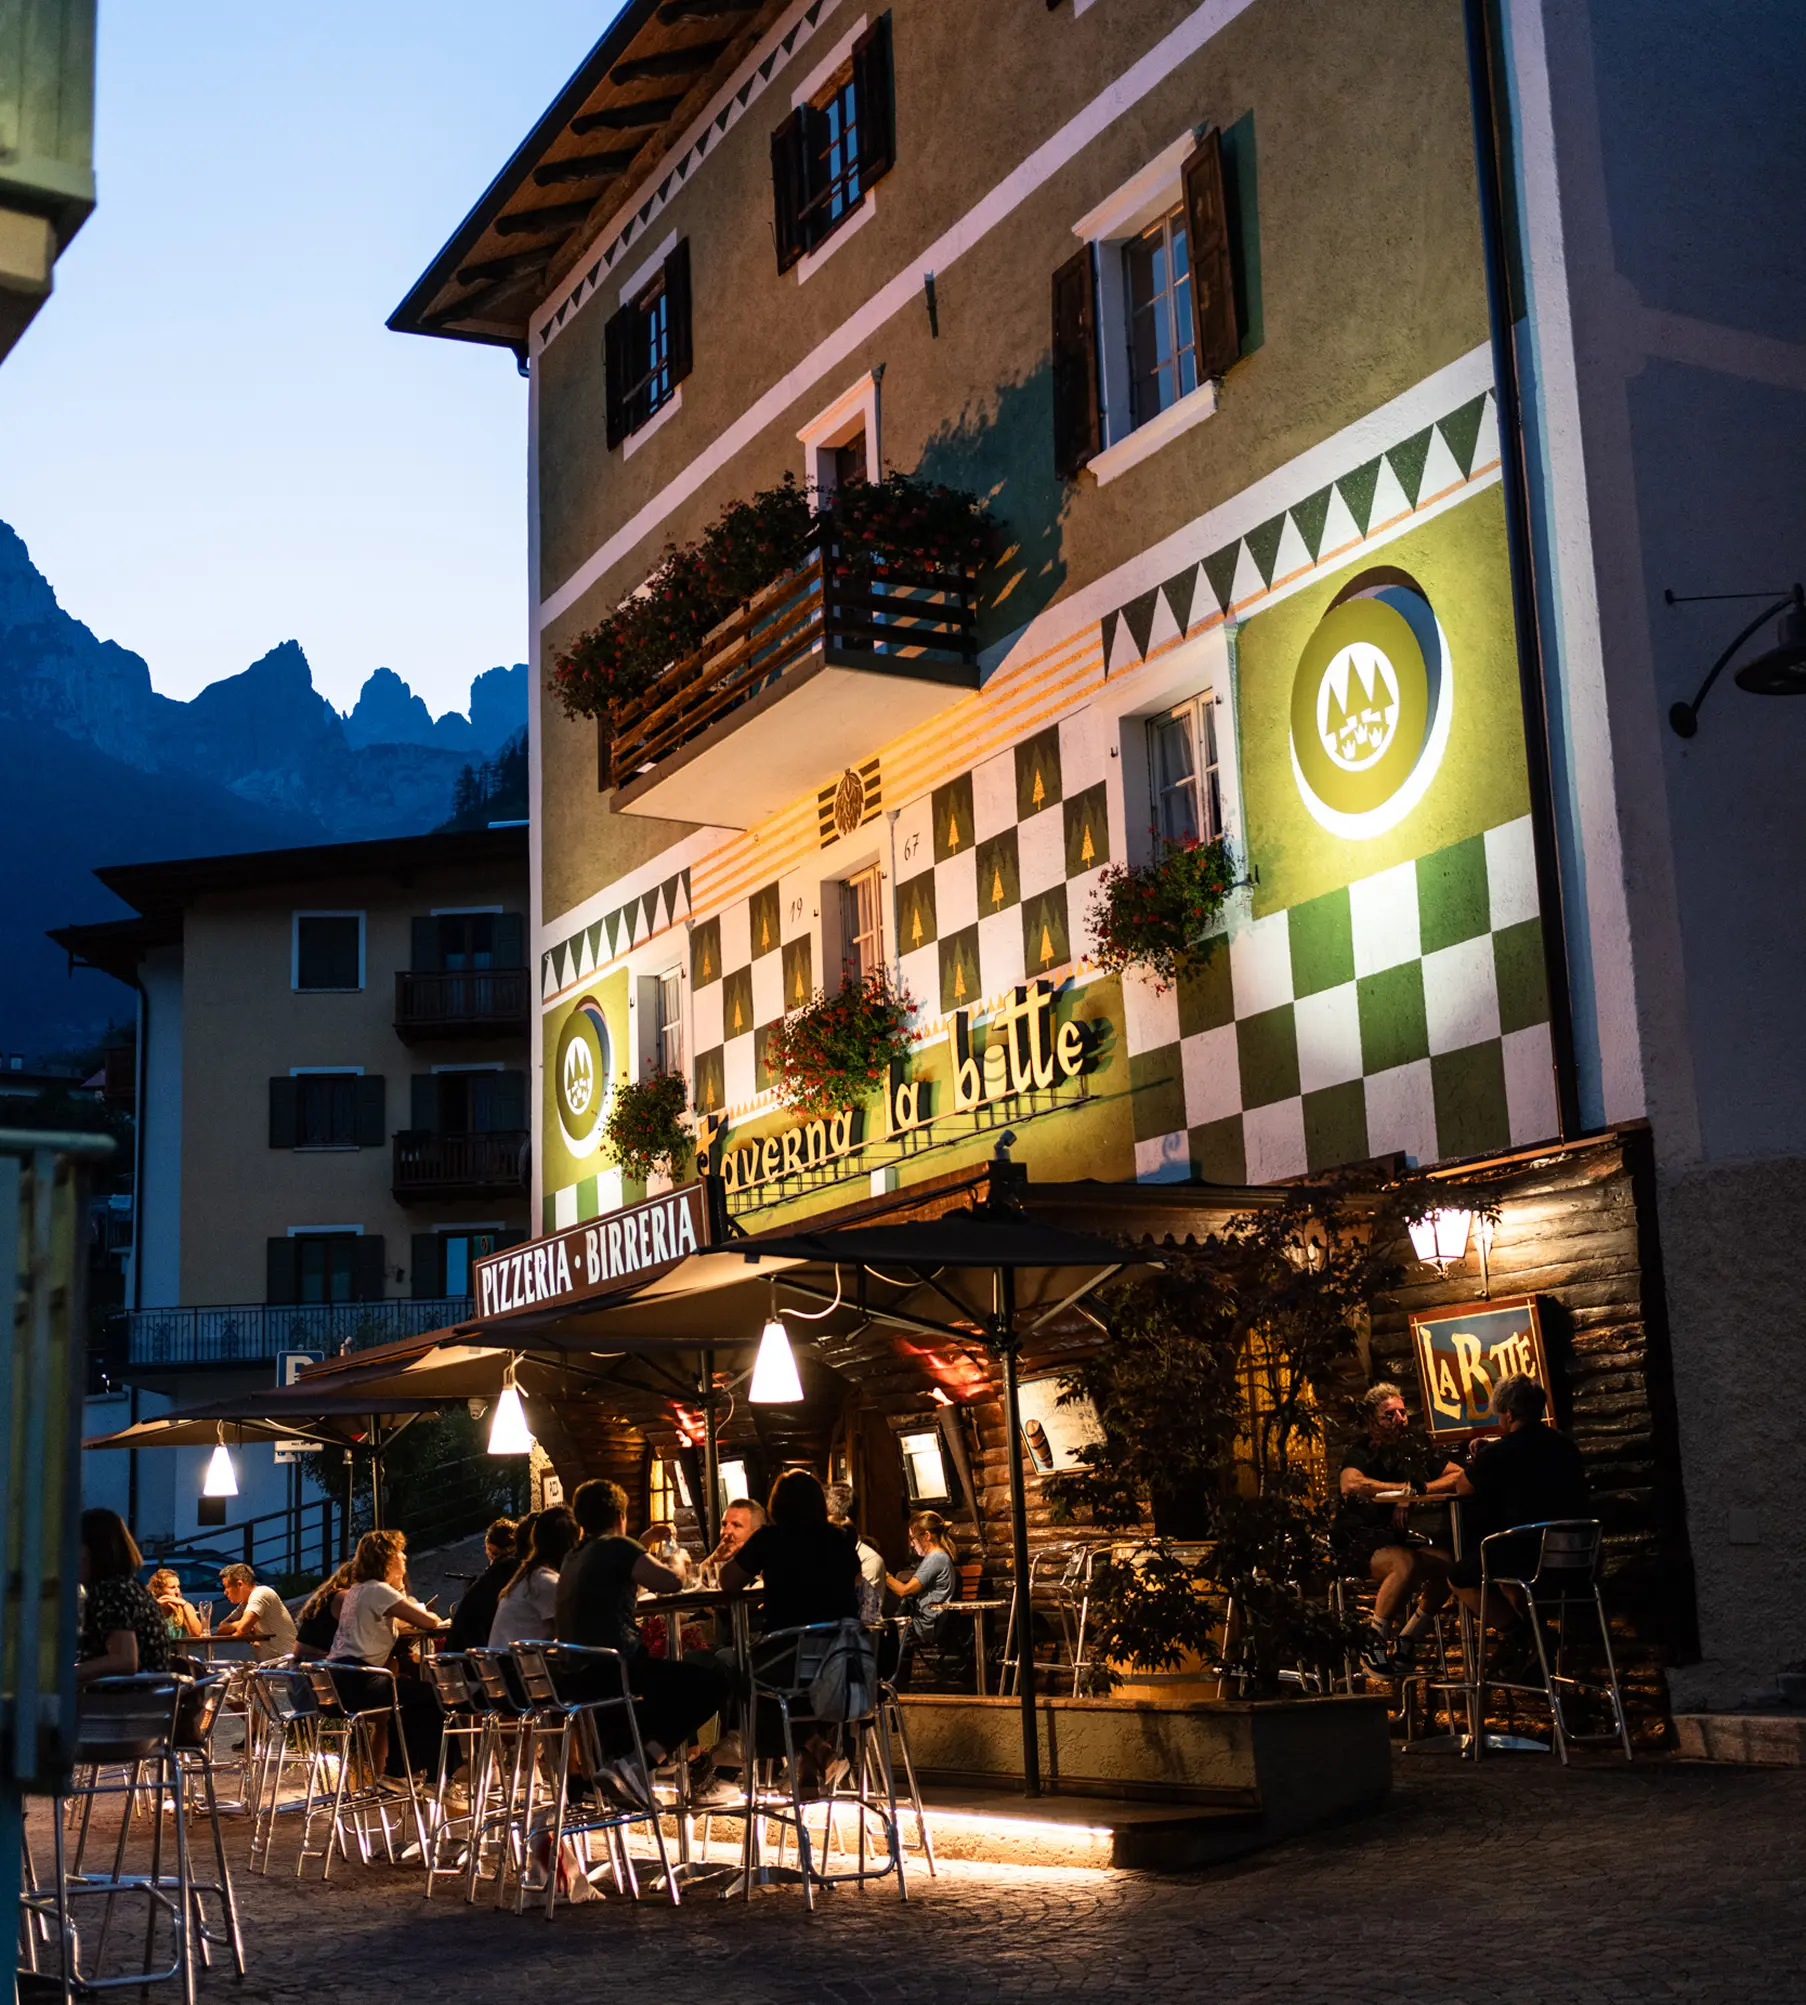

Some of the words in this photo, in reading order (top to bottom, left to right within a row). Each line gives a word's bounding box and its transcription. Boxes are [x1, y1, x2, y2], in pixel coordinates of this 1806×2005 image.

[790, 897, 803, 923] 19
[904, 832, 920, 861] 67
[883, 1063, 919, 1142] la
[481, 1240, 573, 1317] PIZZERIA
[585, 1196, 698, 1284] BIRRERIA
[1419, 1325, 1462, 1420] LA
